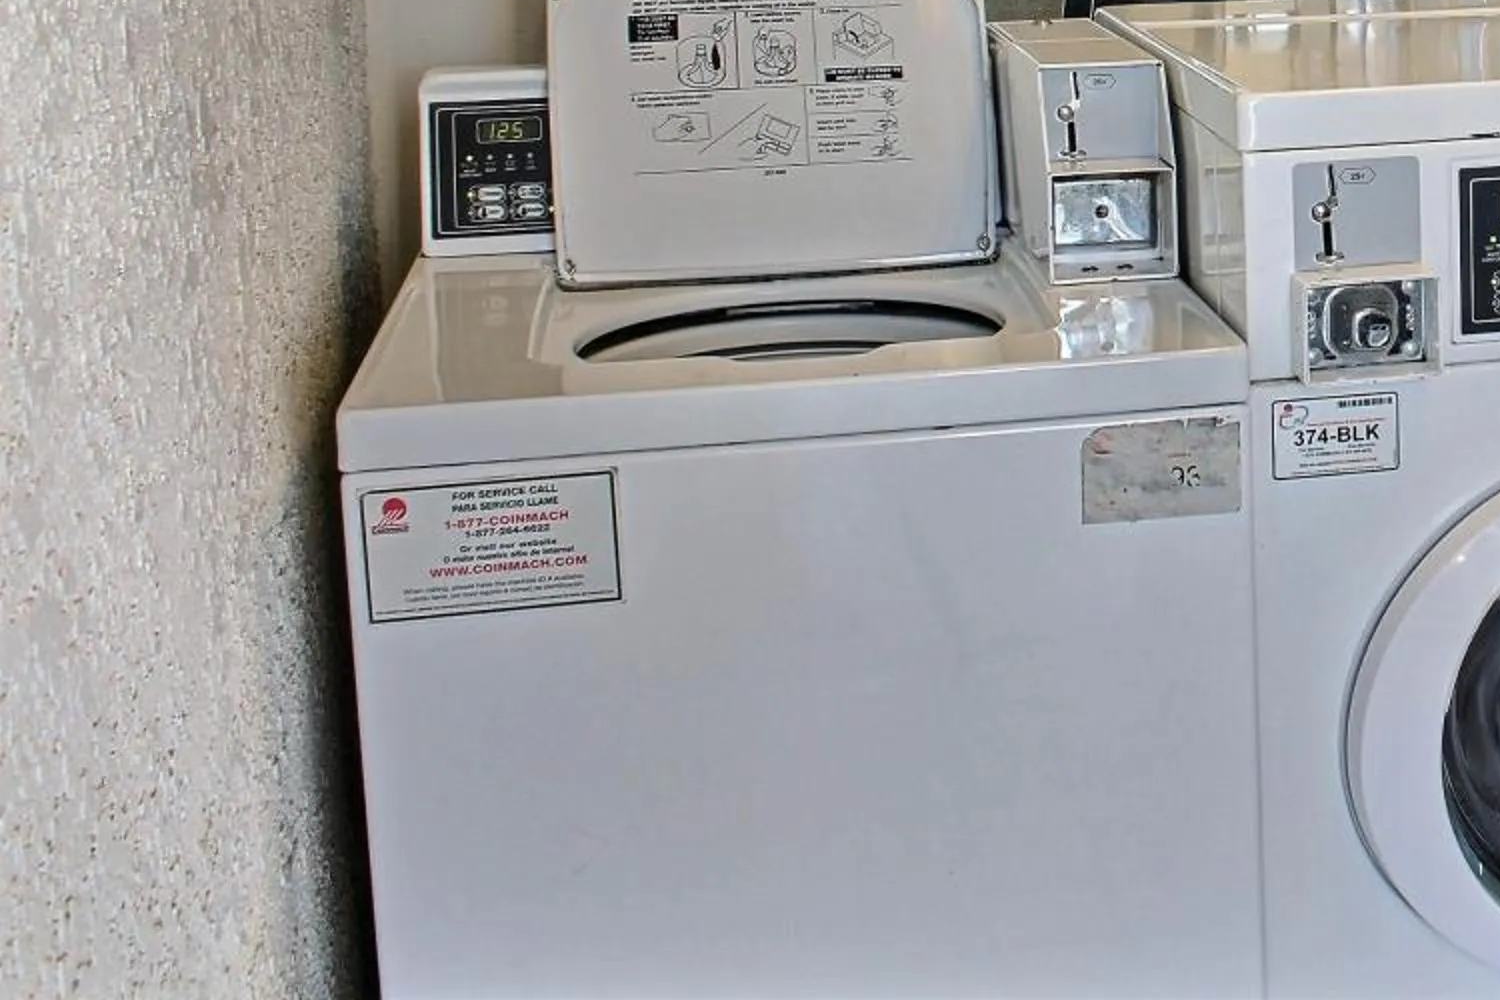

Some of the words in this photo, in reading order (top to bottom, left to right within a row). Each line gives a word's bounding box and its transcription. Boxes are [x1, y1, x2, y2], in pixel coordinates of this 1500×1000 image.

[489, 121, 524, 140] 125
[1293, 423, 1380, 447] 374-BLK
[452, 491, 475, 501] FOR
[478, 486, 526, 499] SERVICE
[529, 484, 558, 495] CALL
[444, 510, 569, 530] 1-877-COINMACH
[429, 554, 588, 578] WWW.COINMACH.COM
